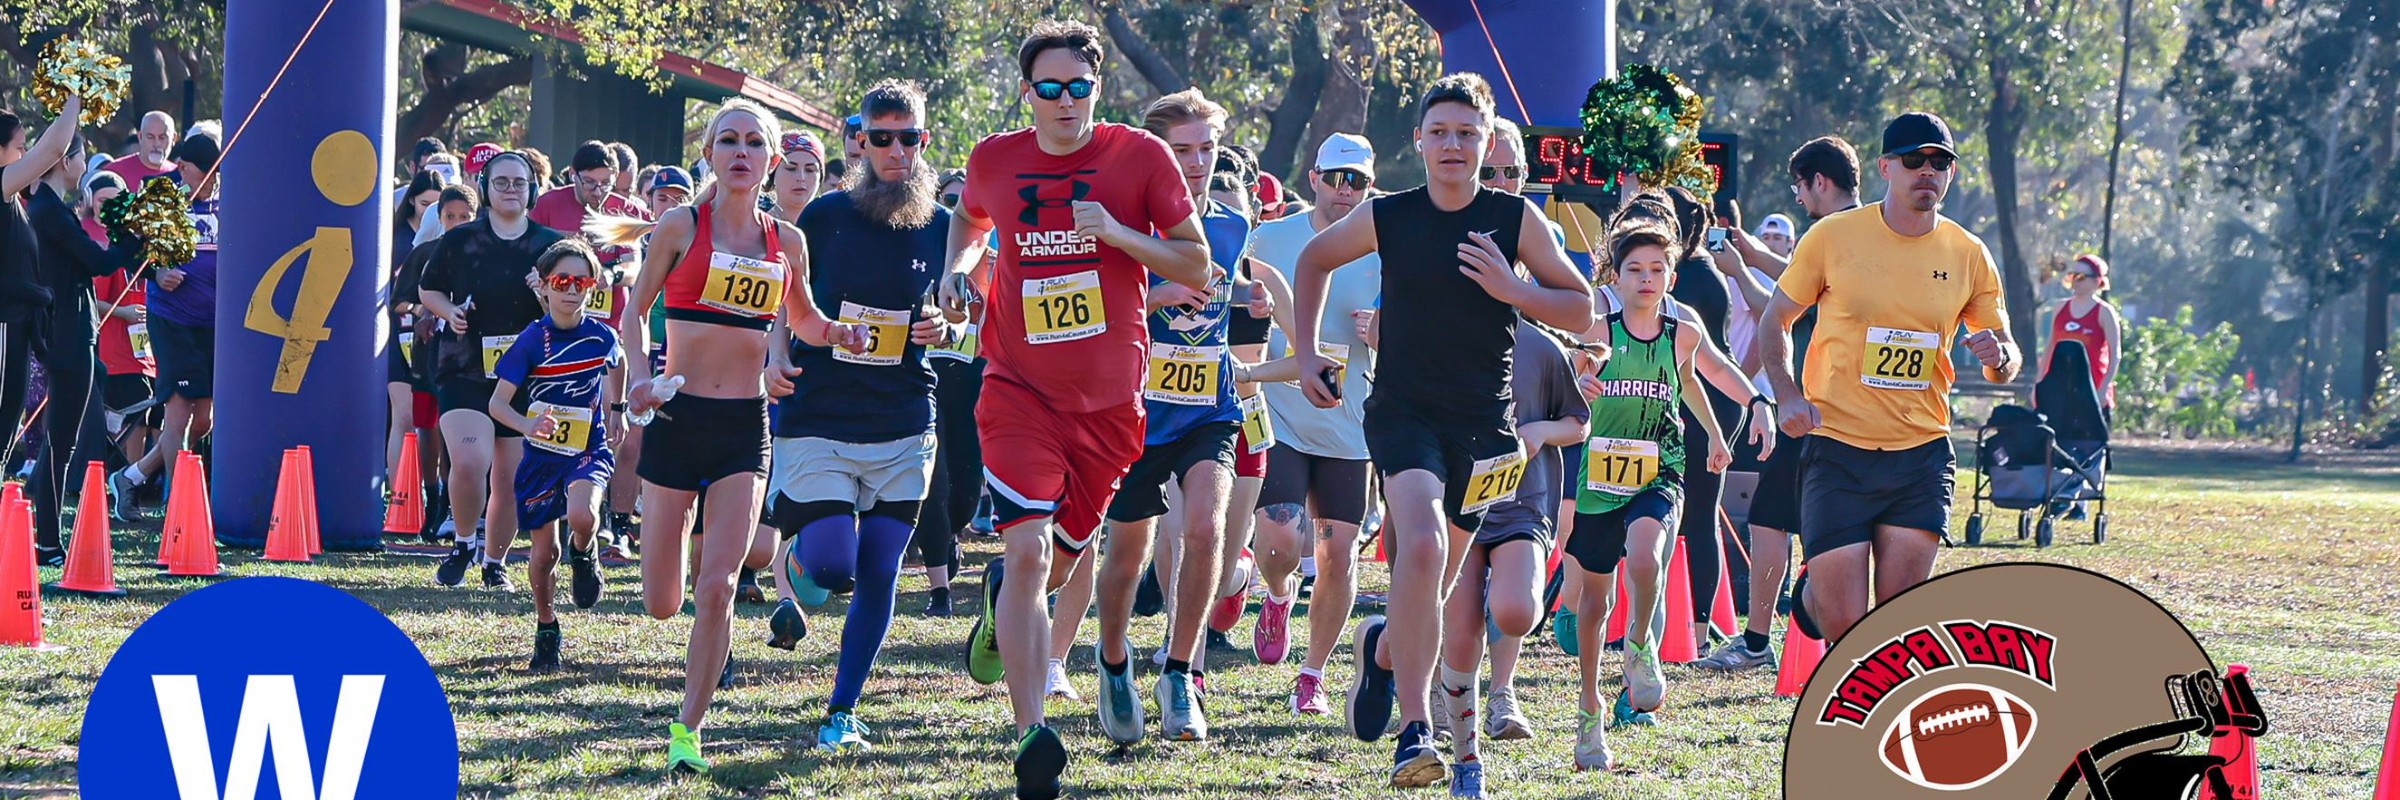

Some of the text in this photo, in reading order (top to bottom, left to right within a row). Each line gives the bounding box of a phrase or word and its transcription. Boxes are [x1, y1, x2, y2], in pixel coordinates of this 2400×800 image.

[1020, 243, 1097, 256] ARMOUR
[722, 274, 769, 309] 130
[1046, 277, 1067, 287] RUN
[1038, 292, 1090, 329] 126
[1160, 362, 1206, 393] 205
[1876, 346, 1923, 378] 228
[1602, 380, 1673, 402] HARRIERS
[1477, 464, 1520, 501] 216
[1602, 455, 1643, 485] 171
